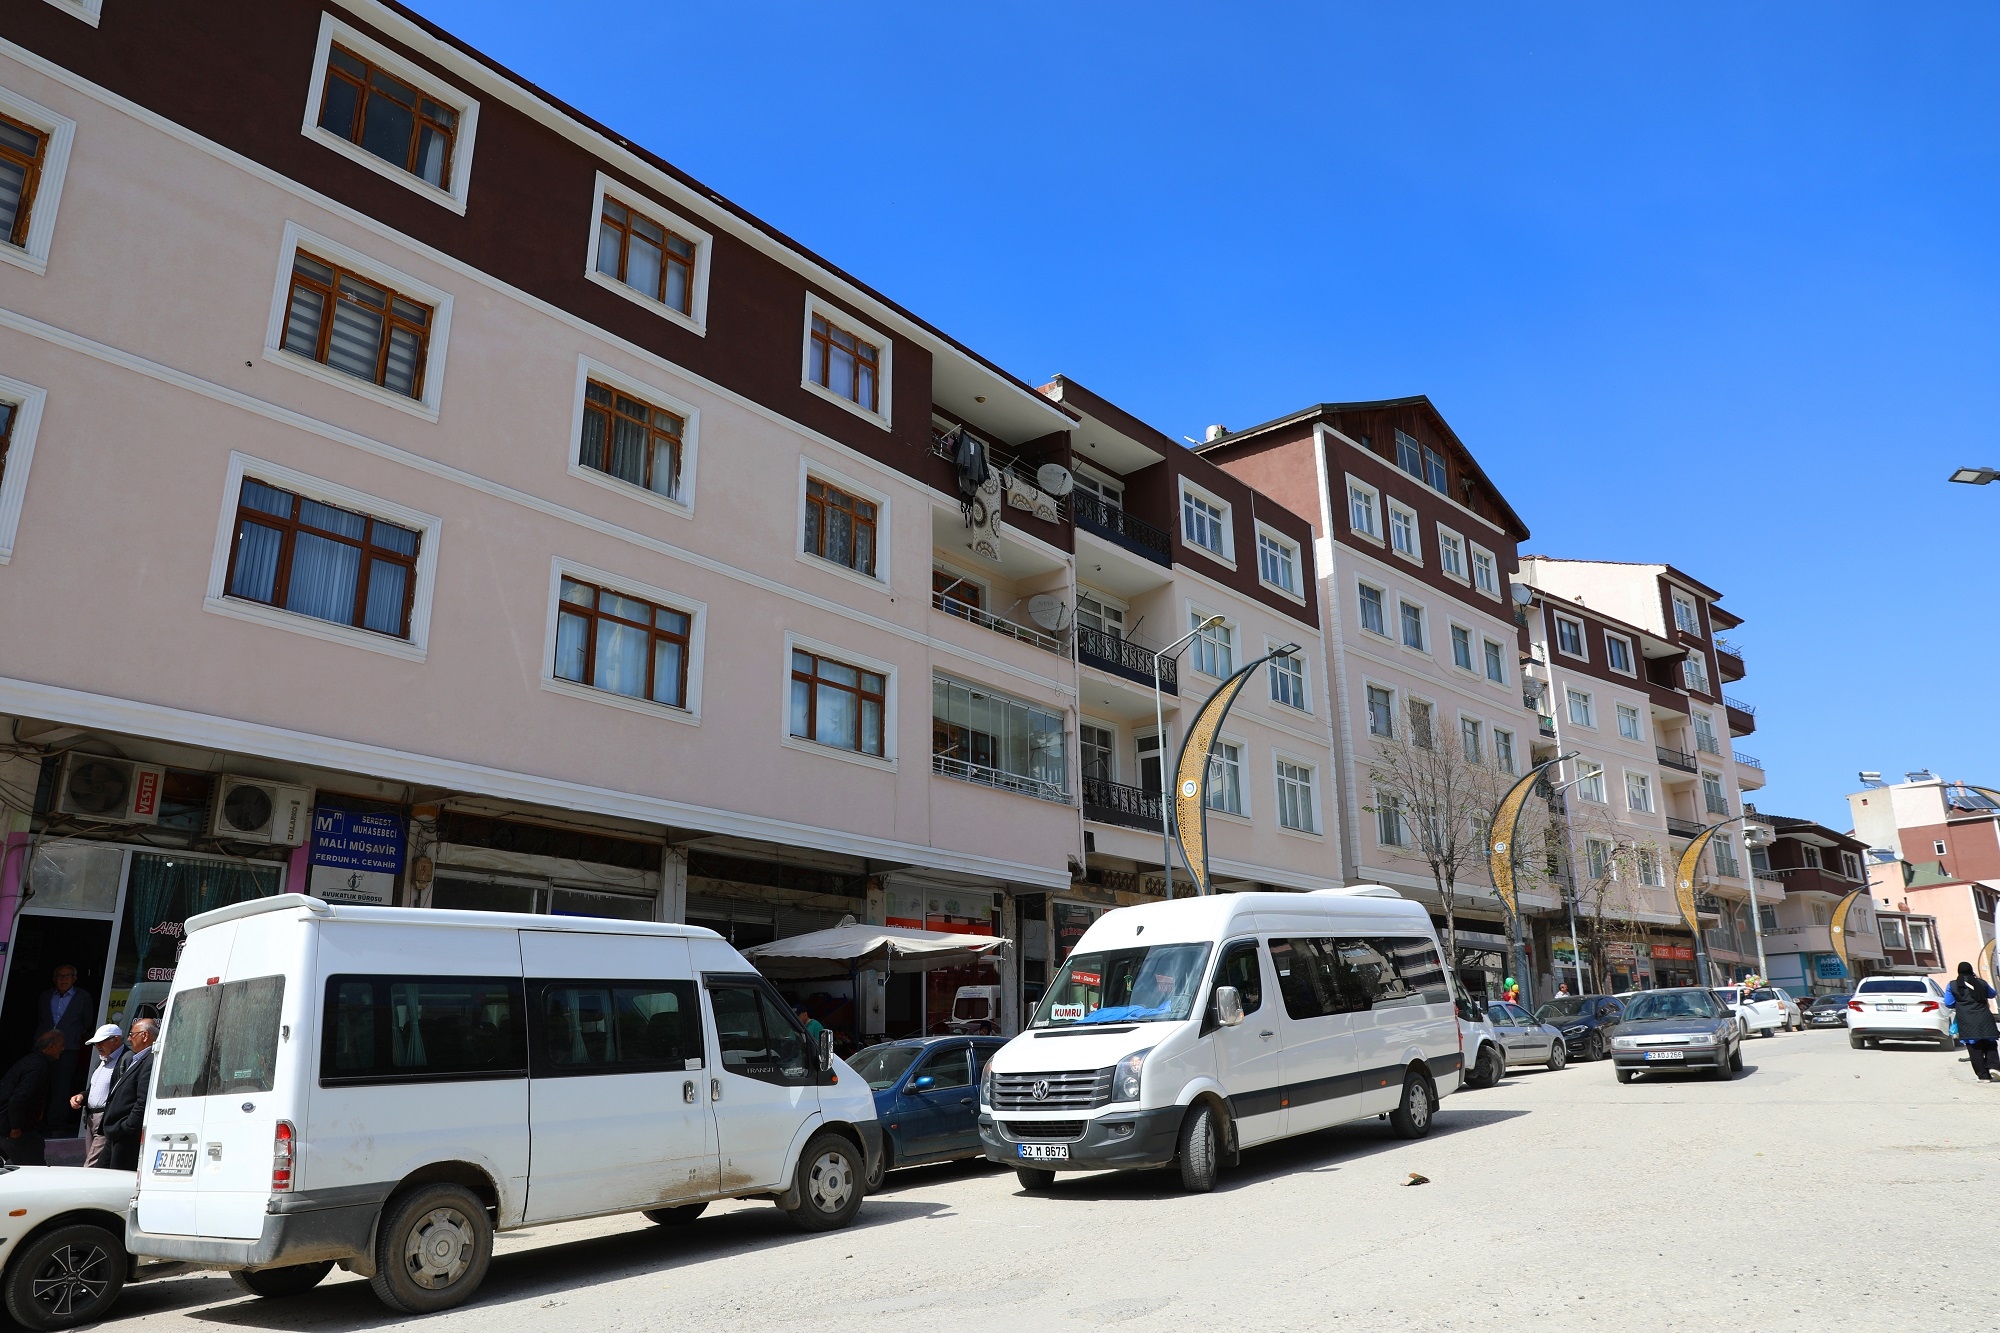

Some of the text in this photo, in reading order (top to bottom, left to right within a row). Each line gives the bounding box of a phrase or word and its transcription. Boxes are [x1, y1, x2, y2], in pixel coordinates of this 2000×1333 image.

[139, 773, 155, 813] VESTEL
[288, 806, 298, 834] ALARKO
[362, 815, 392, 827] SERBEST
[352, 824, 397, 838] MUHASEBECİ
[319, 837, 396, 856] MALİ MÜŞAVİR
[315, 853, 396, 869] FERDUN H. CEVAHİR
[321, 890, 383, 903] AVUKATLIK BÜROSU
[149, 921, 184, 938] Akif
[148, 967, 177, 980] ERKE
[1054, 1008, 1082, 1017] KUMRU
[746, 1066, 775, 1074] TRANSIT
[156, 1107, 177, 1116] TRANSIT
[1022, 1146, 1067, 1157] 52 M 8673
[158, 1153, 194, 1169] 52 M 8508
